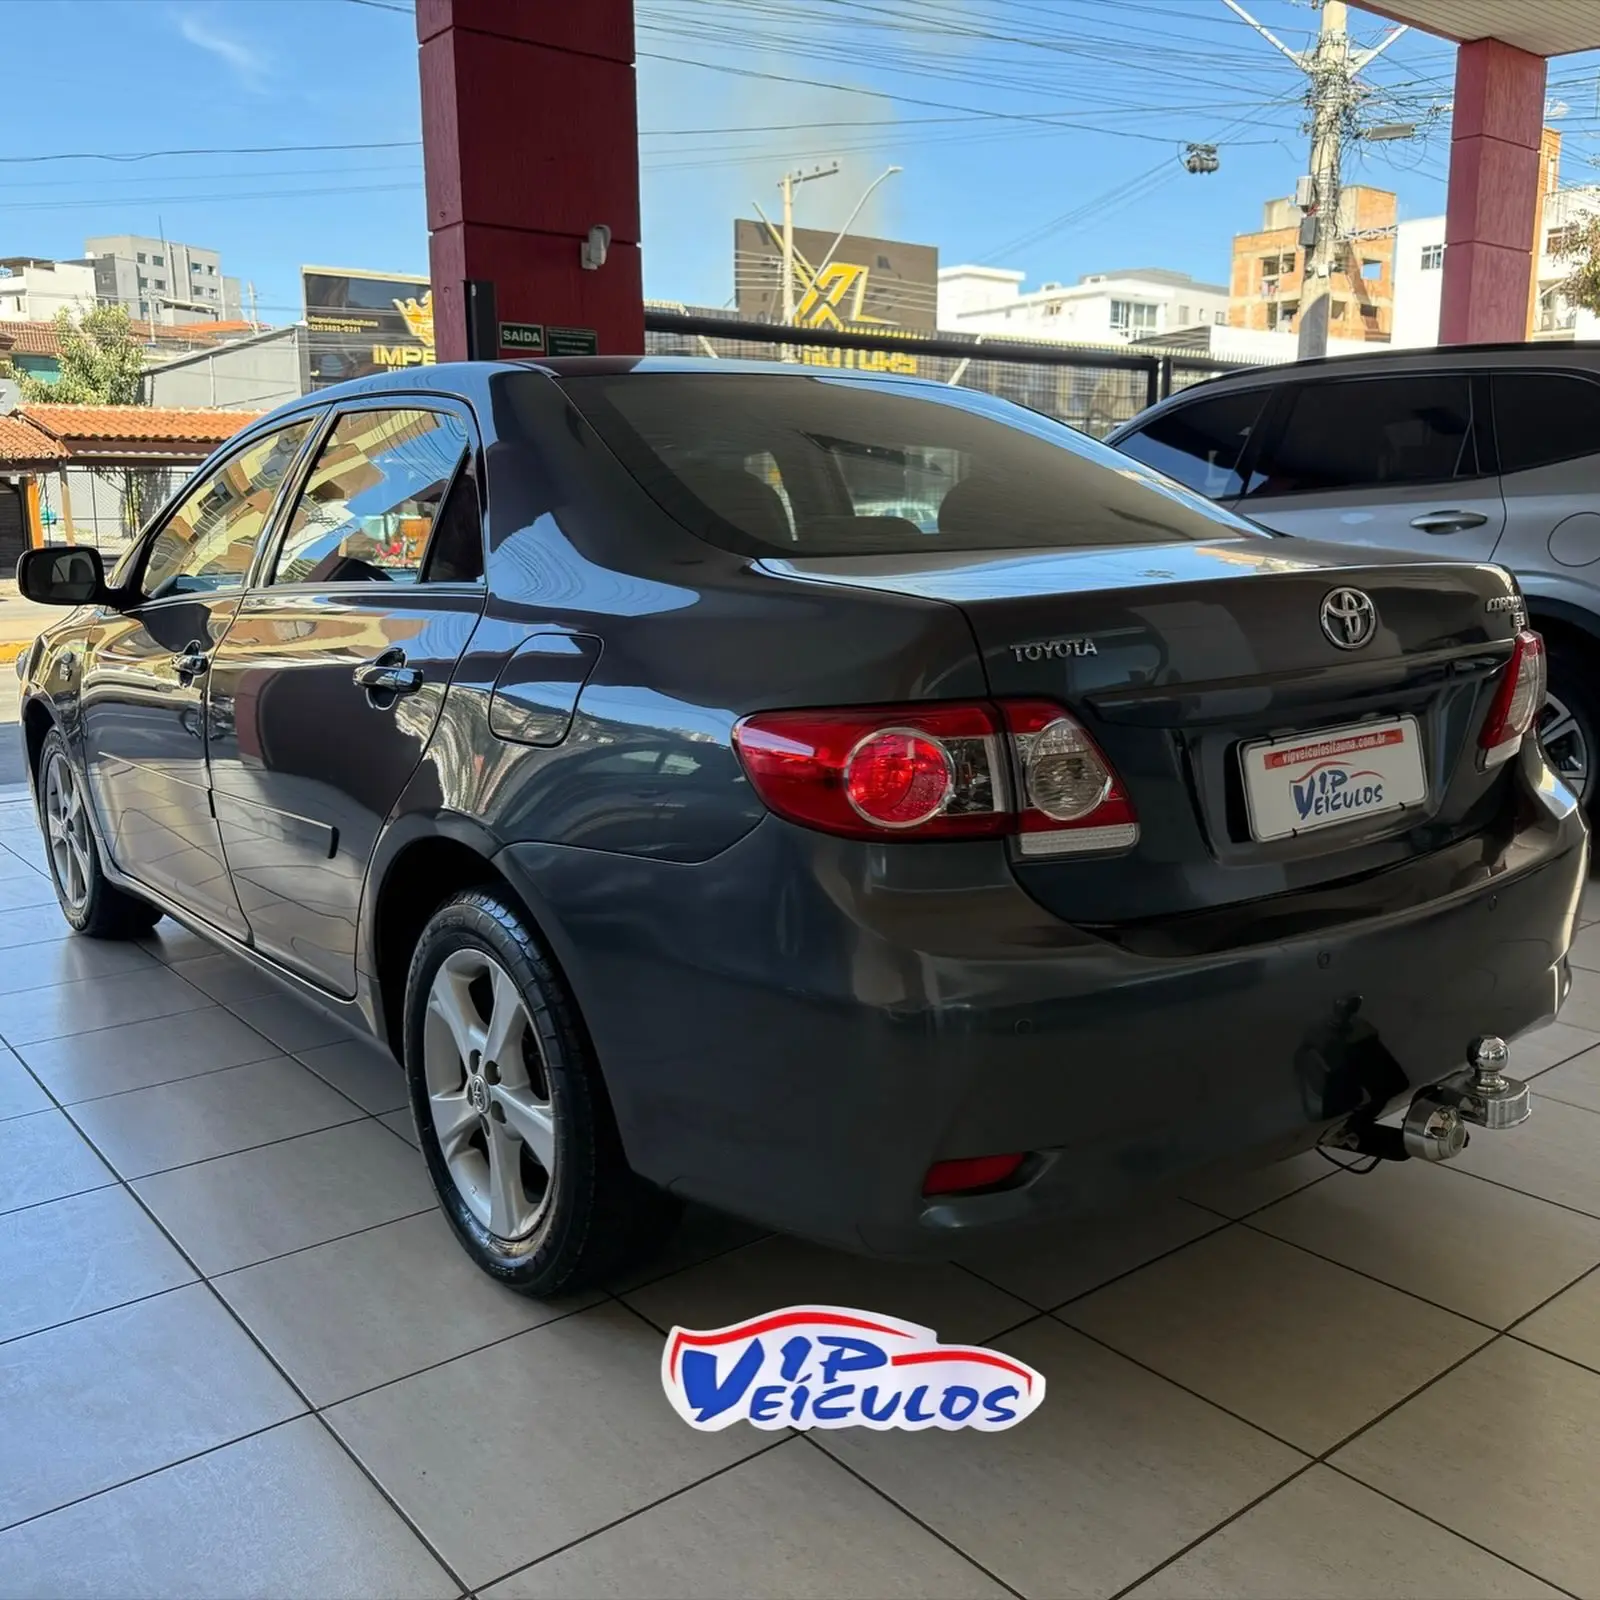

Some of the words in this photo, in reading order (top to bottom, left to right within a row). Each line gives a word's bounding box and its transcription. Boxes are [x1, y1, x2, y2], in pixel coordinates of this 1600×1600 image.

[503, 328, 540, 343] SAÍDA
[1010, 639, 1098, 662] TOYOTA
[1293, 769, 1348, 820] VIP
